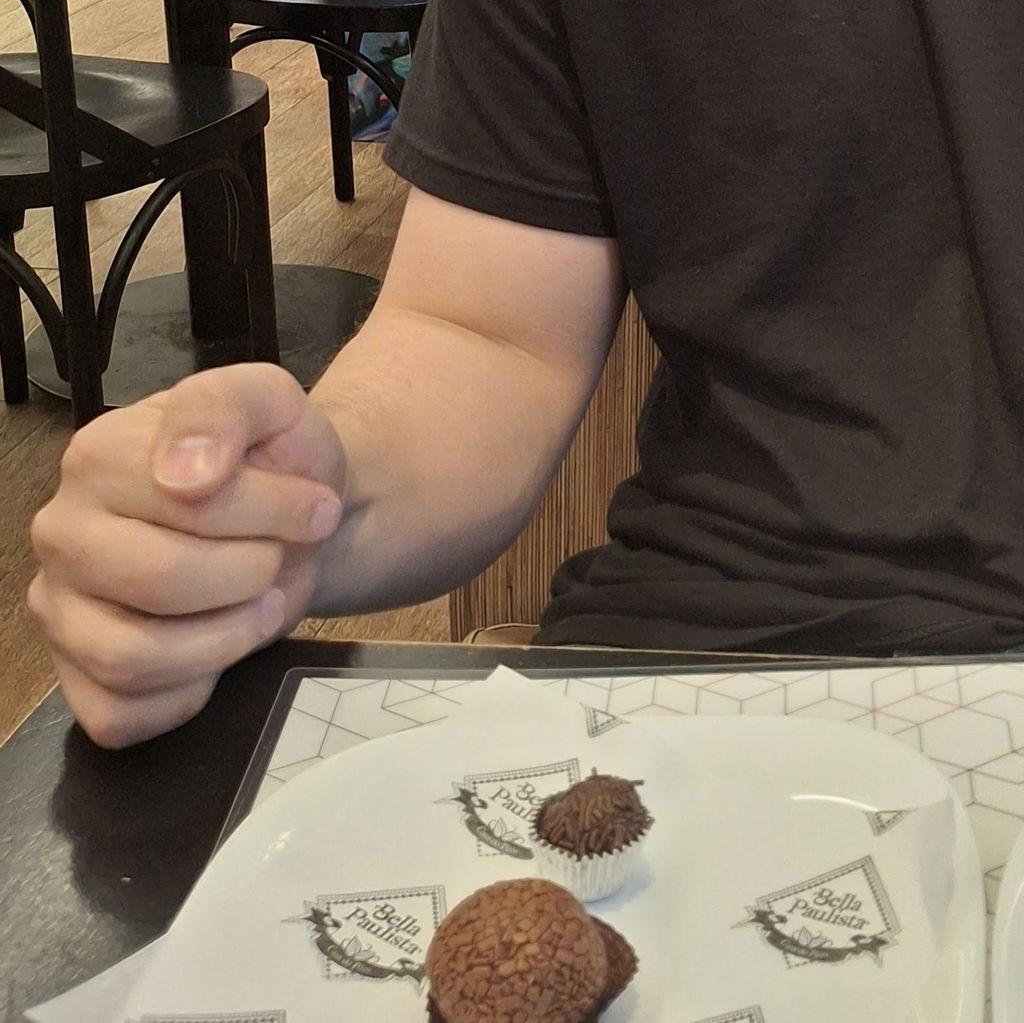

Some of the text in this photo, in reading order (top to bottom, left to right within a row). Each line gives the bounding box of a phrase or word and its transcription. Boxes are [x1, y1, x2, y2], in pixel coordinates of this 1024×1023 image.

[489, 785, 536, 820] Paul
[787, 898, 866, 931] Paulista
[813, 887, 863, 912] Bella
[345, 905, 420, 955] Paulista
[373, 902, 422, 937] Bella
